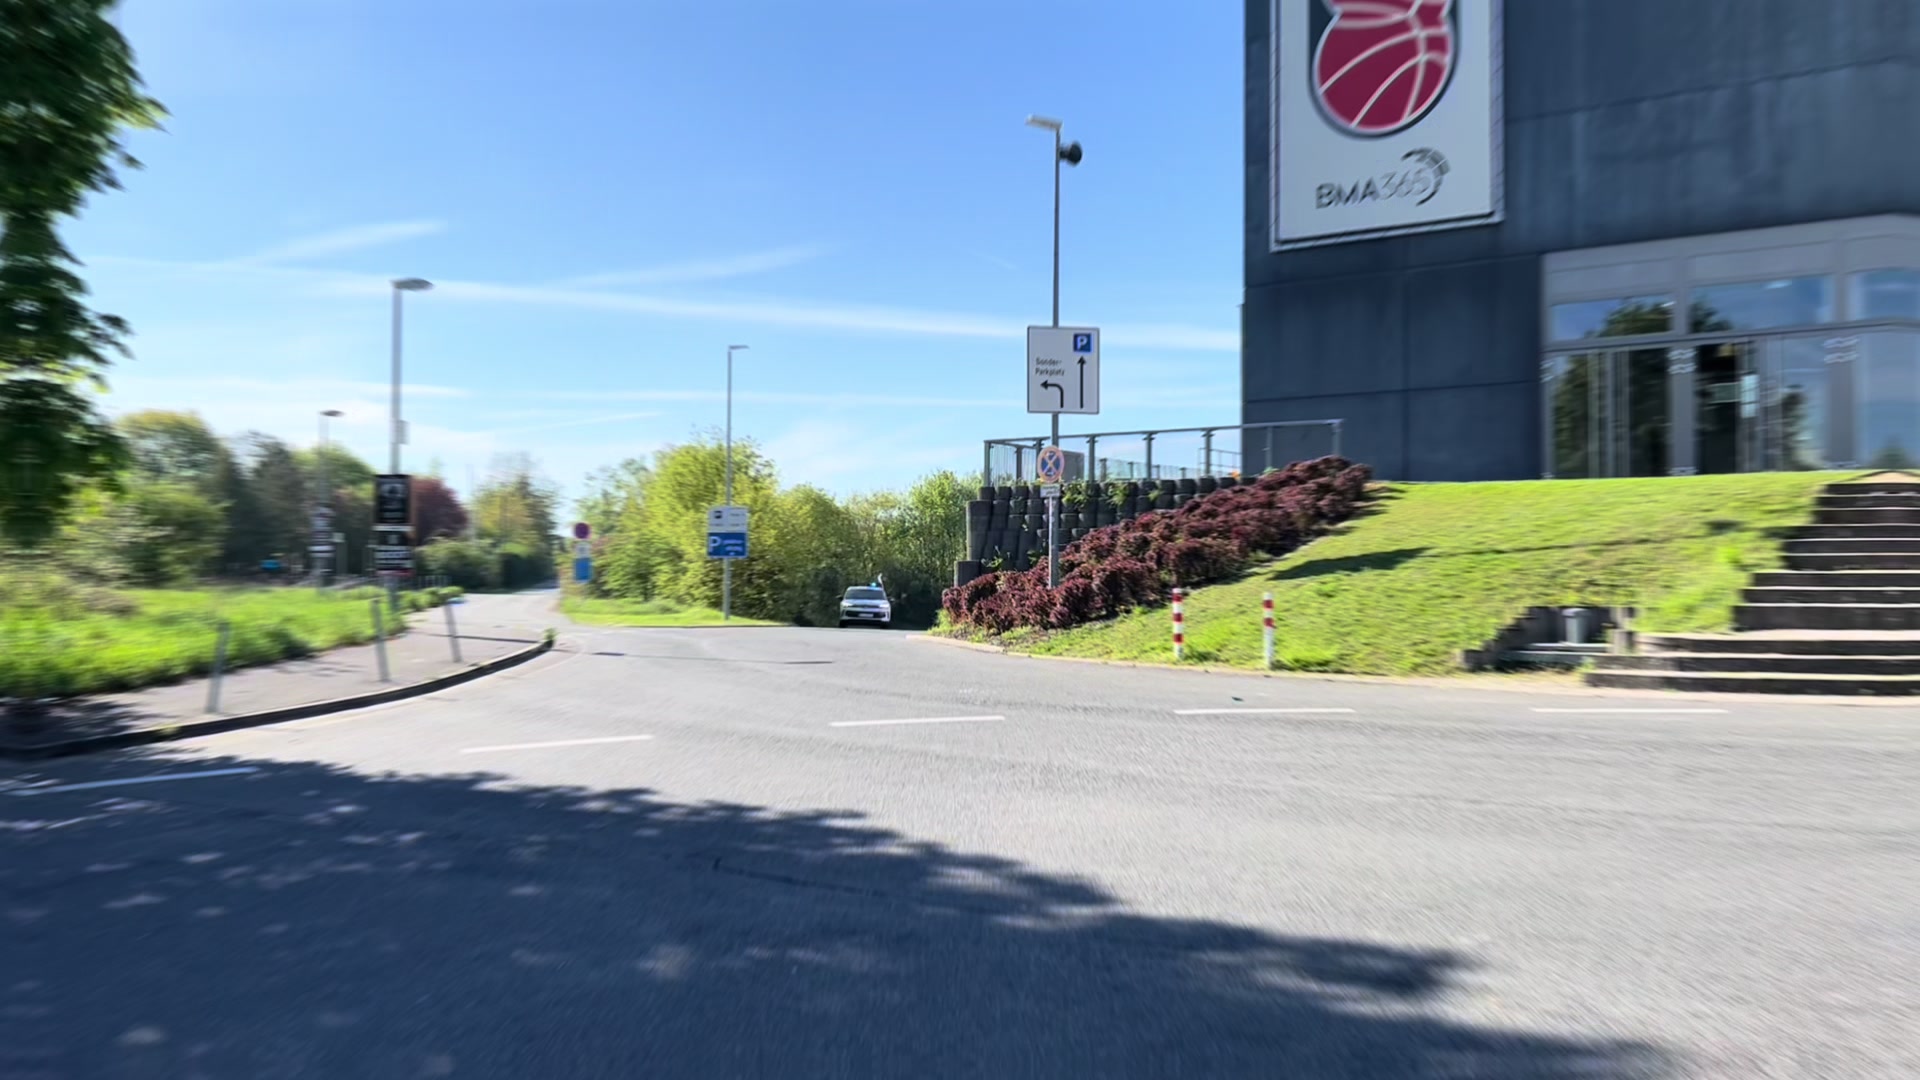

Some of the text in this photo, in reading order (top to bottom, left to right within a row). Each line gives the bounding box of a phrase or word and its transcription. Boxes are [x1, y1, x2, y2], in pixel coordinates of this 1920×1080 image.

[1316, 168, 1431, 209] BMA365
[1077, 335, 1088, 350] P
[1035, 357, 1062, 366] Sonder-
[1035, 367, 1065, 376] Parkplatz
[709, 536, 721, 552] P
